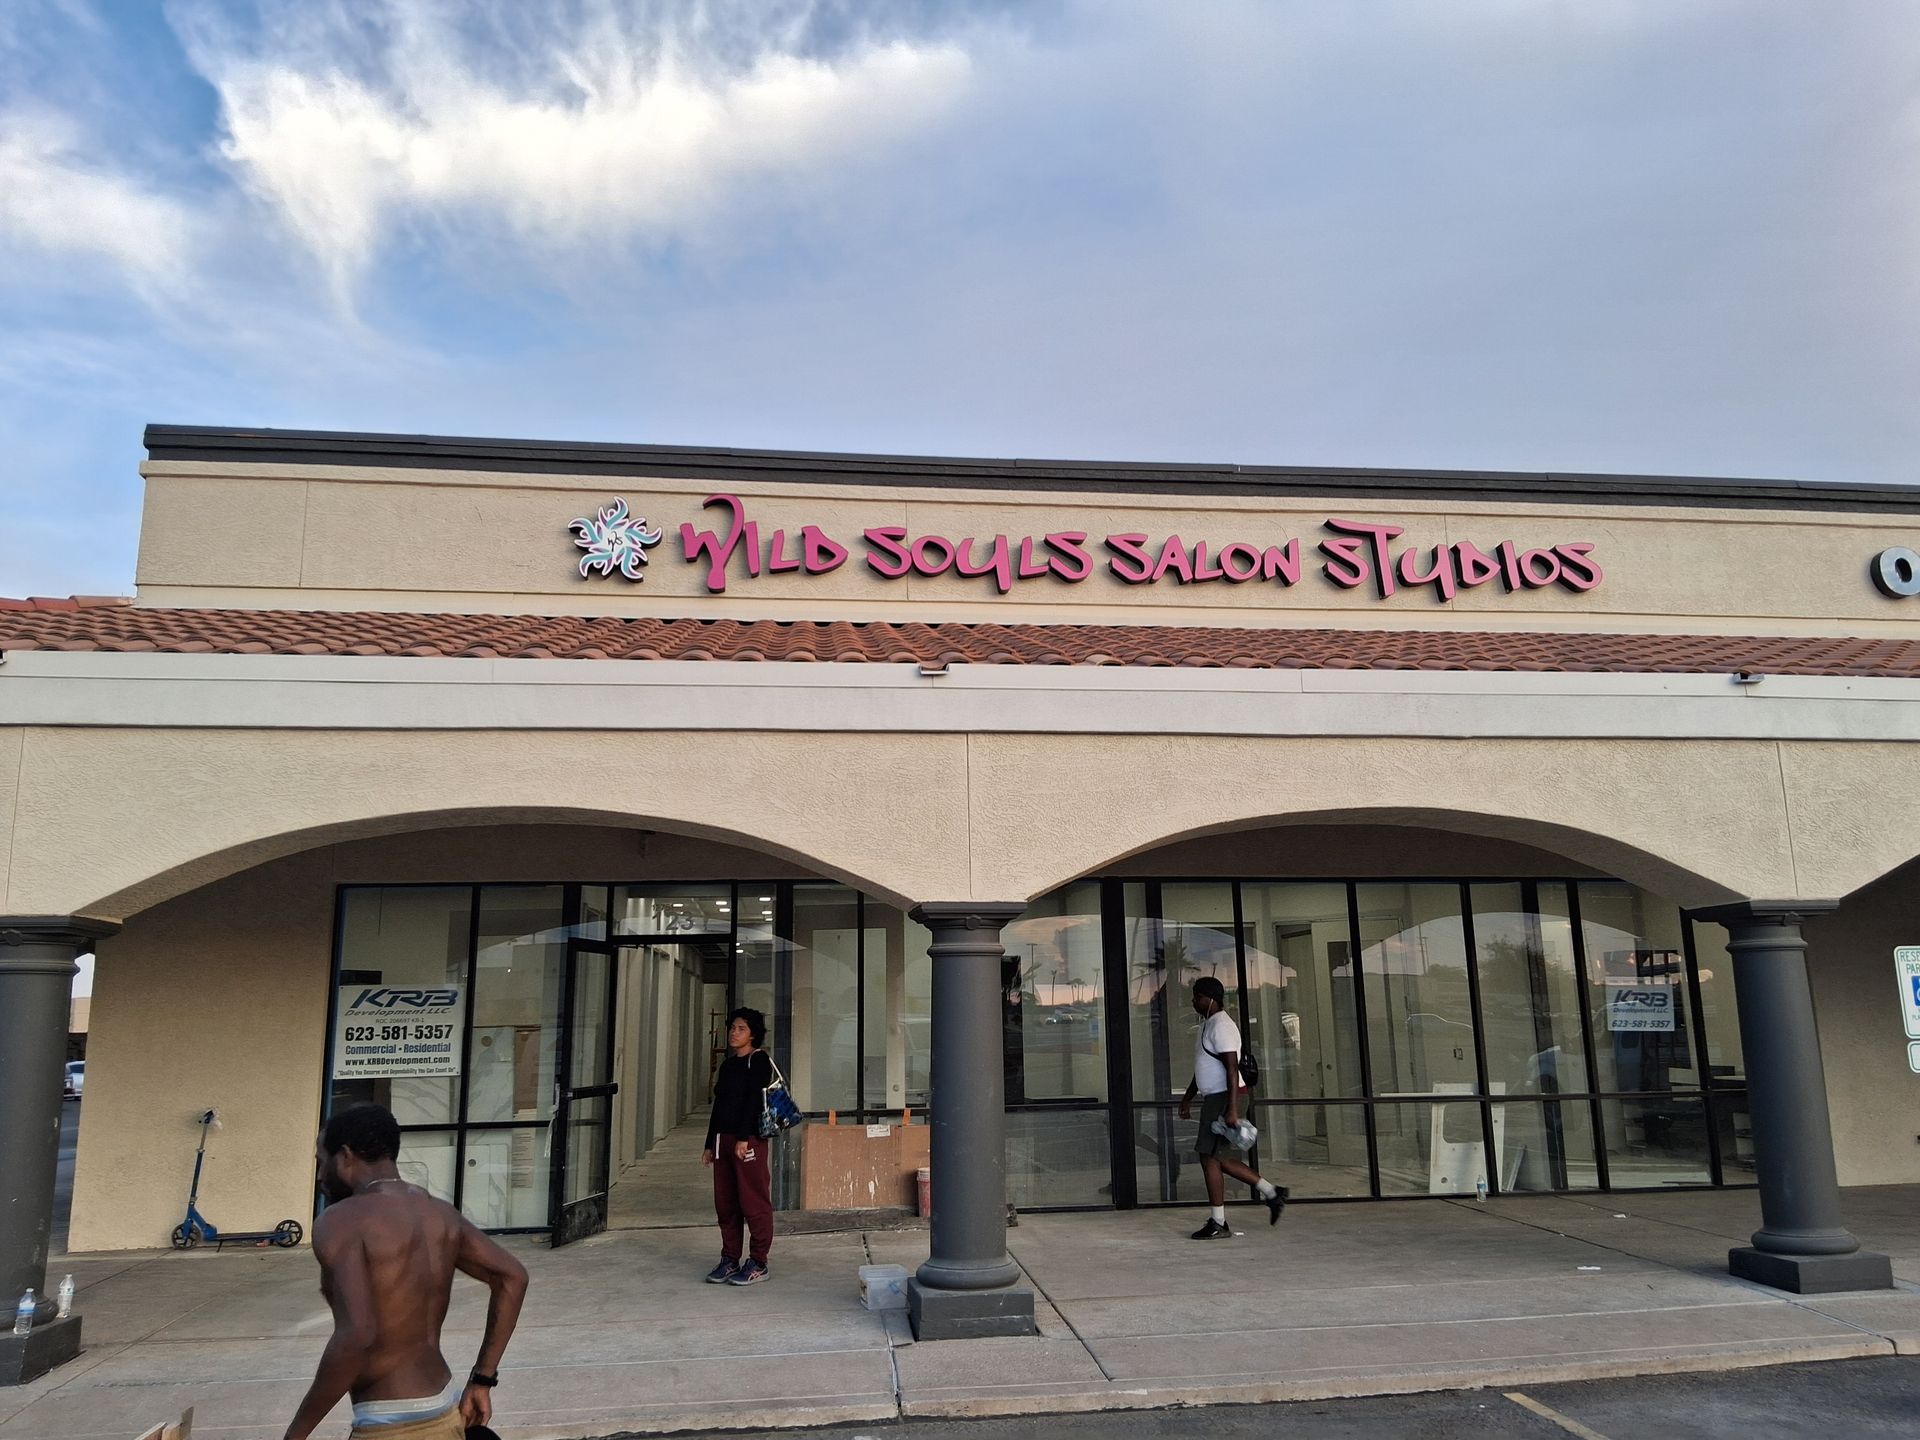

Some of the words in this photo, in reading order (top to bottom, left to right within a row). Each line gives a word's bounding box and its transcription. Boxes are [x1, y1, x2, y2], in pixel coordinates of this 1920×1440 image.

[680, 494, 848, 593] WILD
[864, 526, 1094, 595] SOULS
[1105, 532, 1299, 586] SALON
[1318, 517, 1603, 602] STUDIOS
[652, 911, 694, 931] 123
[350, 988, 459, 1009] KRB
[1614, 989, 1668, 1007] KRB
[345, 1008, 426, 1017] Development
[1612, 1020, 1671, 1028] 623-581-5357
[345, 1025, 454, 1041] 623-581-5357
[345, 1044, 397, 1055] Commercial
[403, 1042, 451, 1053] Residential
[345, 1056, 451, 1066] www.KRBDevelopment.com
